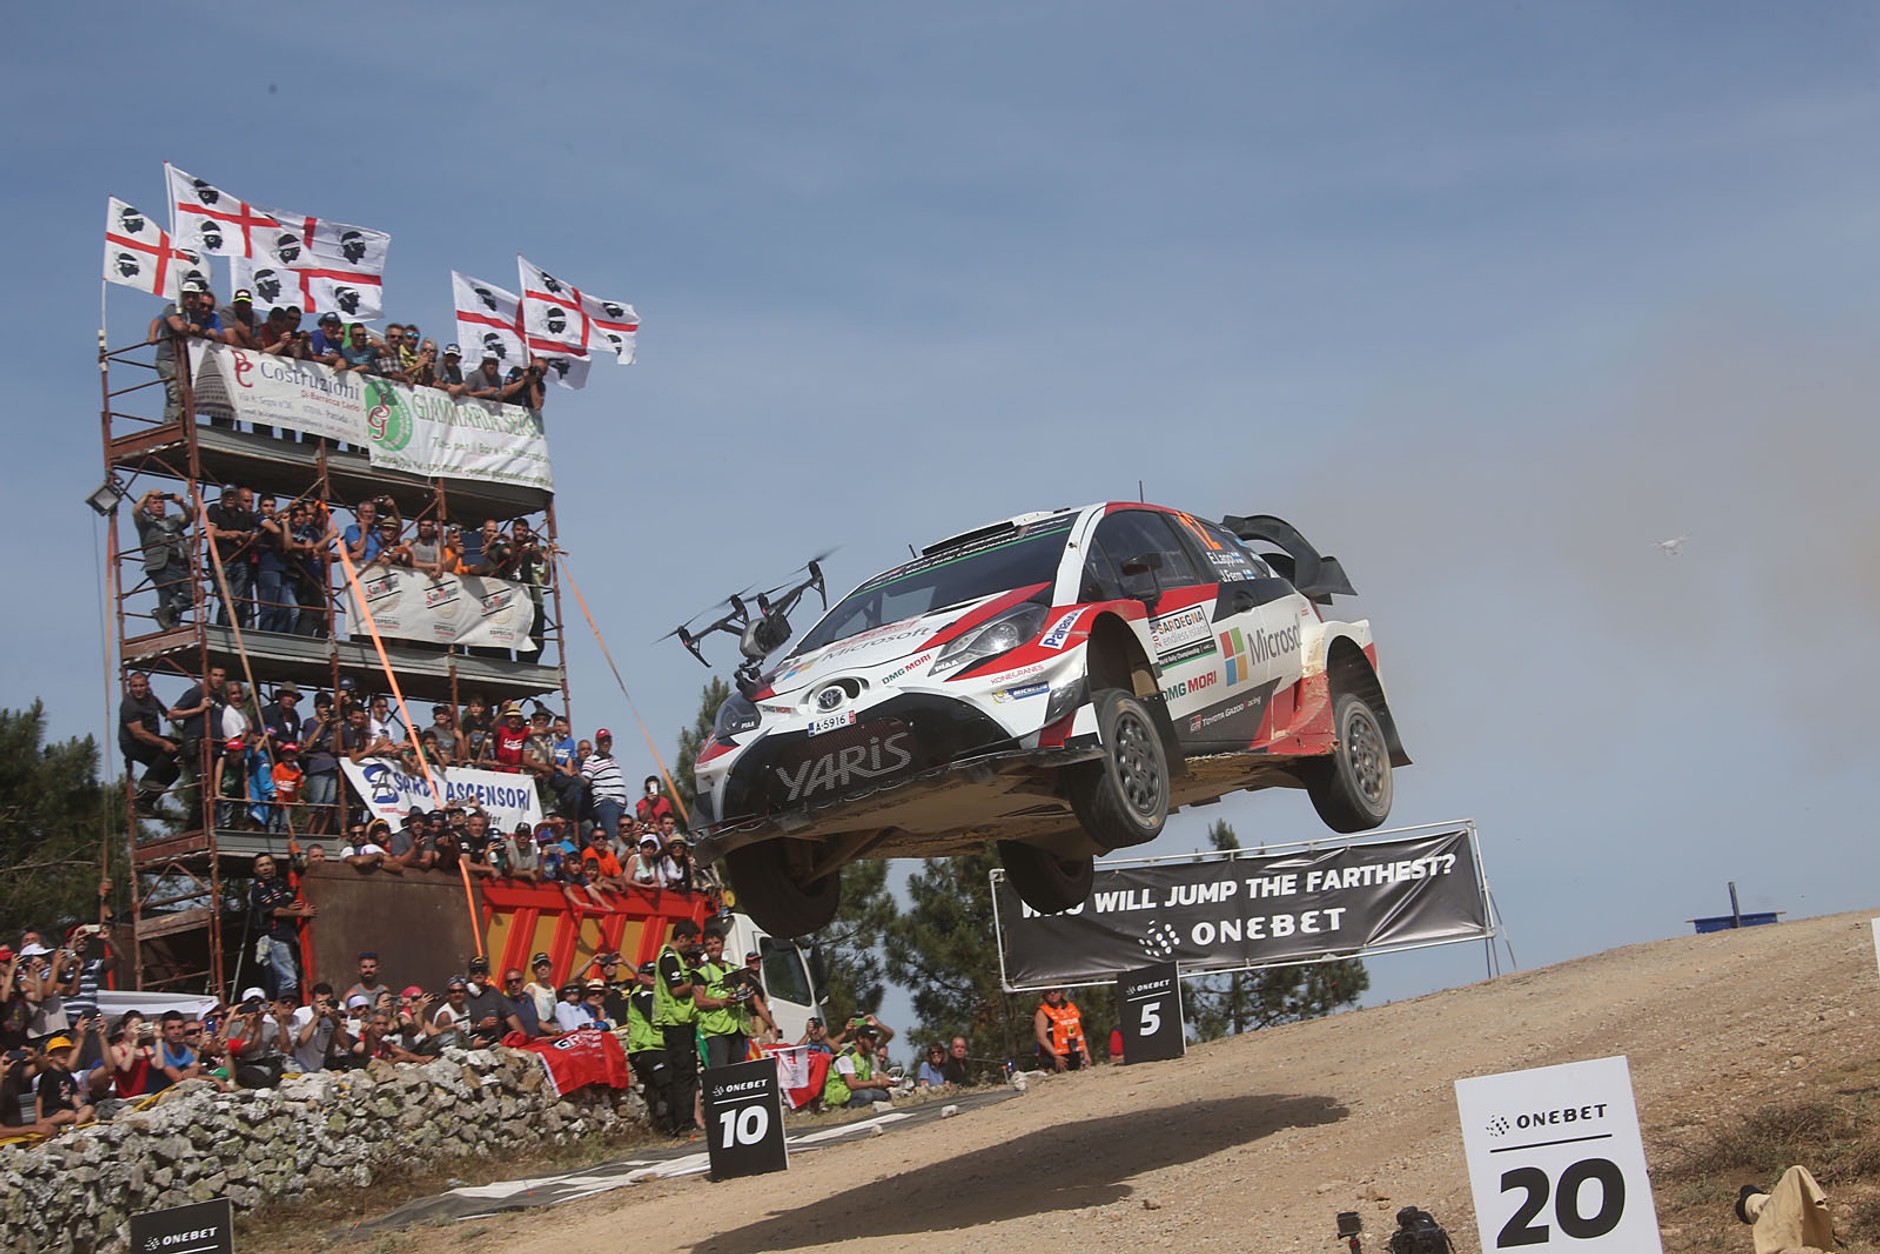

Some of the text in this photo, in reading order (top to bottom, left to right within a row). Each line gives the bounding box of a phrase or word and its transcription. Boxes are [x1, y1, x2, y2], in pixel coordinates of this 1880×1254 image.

[260, 361, 360, 400] Costruzioni
[1156, 611, 1204, 634] SARDEGNA
[822, 627, 931, 662] Microsoft
[882, 654, 932, 685] DMG MORI
[935, 659, 959, 672] PIAA
[990, 664, 1045, 685] KONECRANES
[1188, 671, 1217, 693] MORI
[1094, 888, 1157, 913] WILL
[1164, 880, 1238, 907] JUMP
[1246, 873, 1298, 899] THE
[1306, 853, 1457, 893] FARTHEST?
[1191, 907, 1347, 945] ONEBET
[1137, 979, 1170, 992] ONEBET
[1140, 1002, 1160, 1036] 5
[726, 1079, 768, 1093] ONEBET
[720, 1105, 769, 1149] 10
[1517, 1103, 1608, 1129] ONEBET
[1496, 1157, 1626, 1249] 20
[162, 1227, 218, 1246] ONEBET
